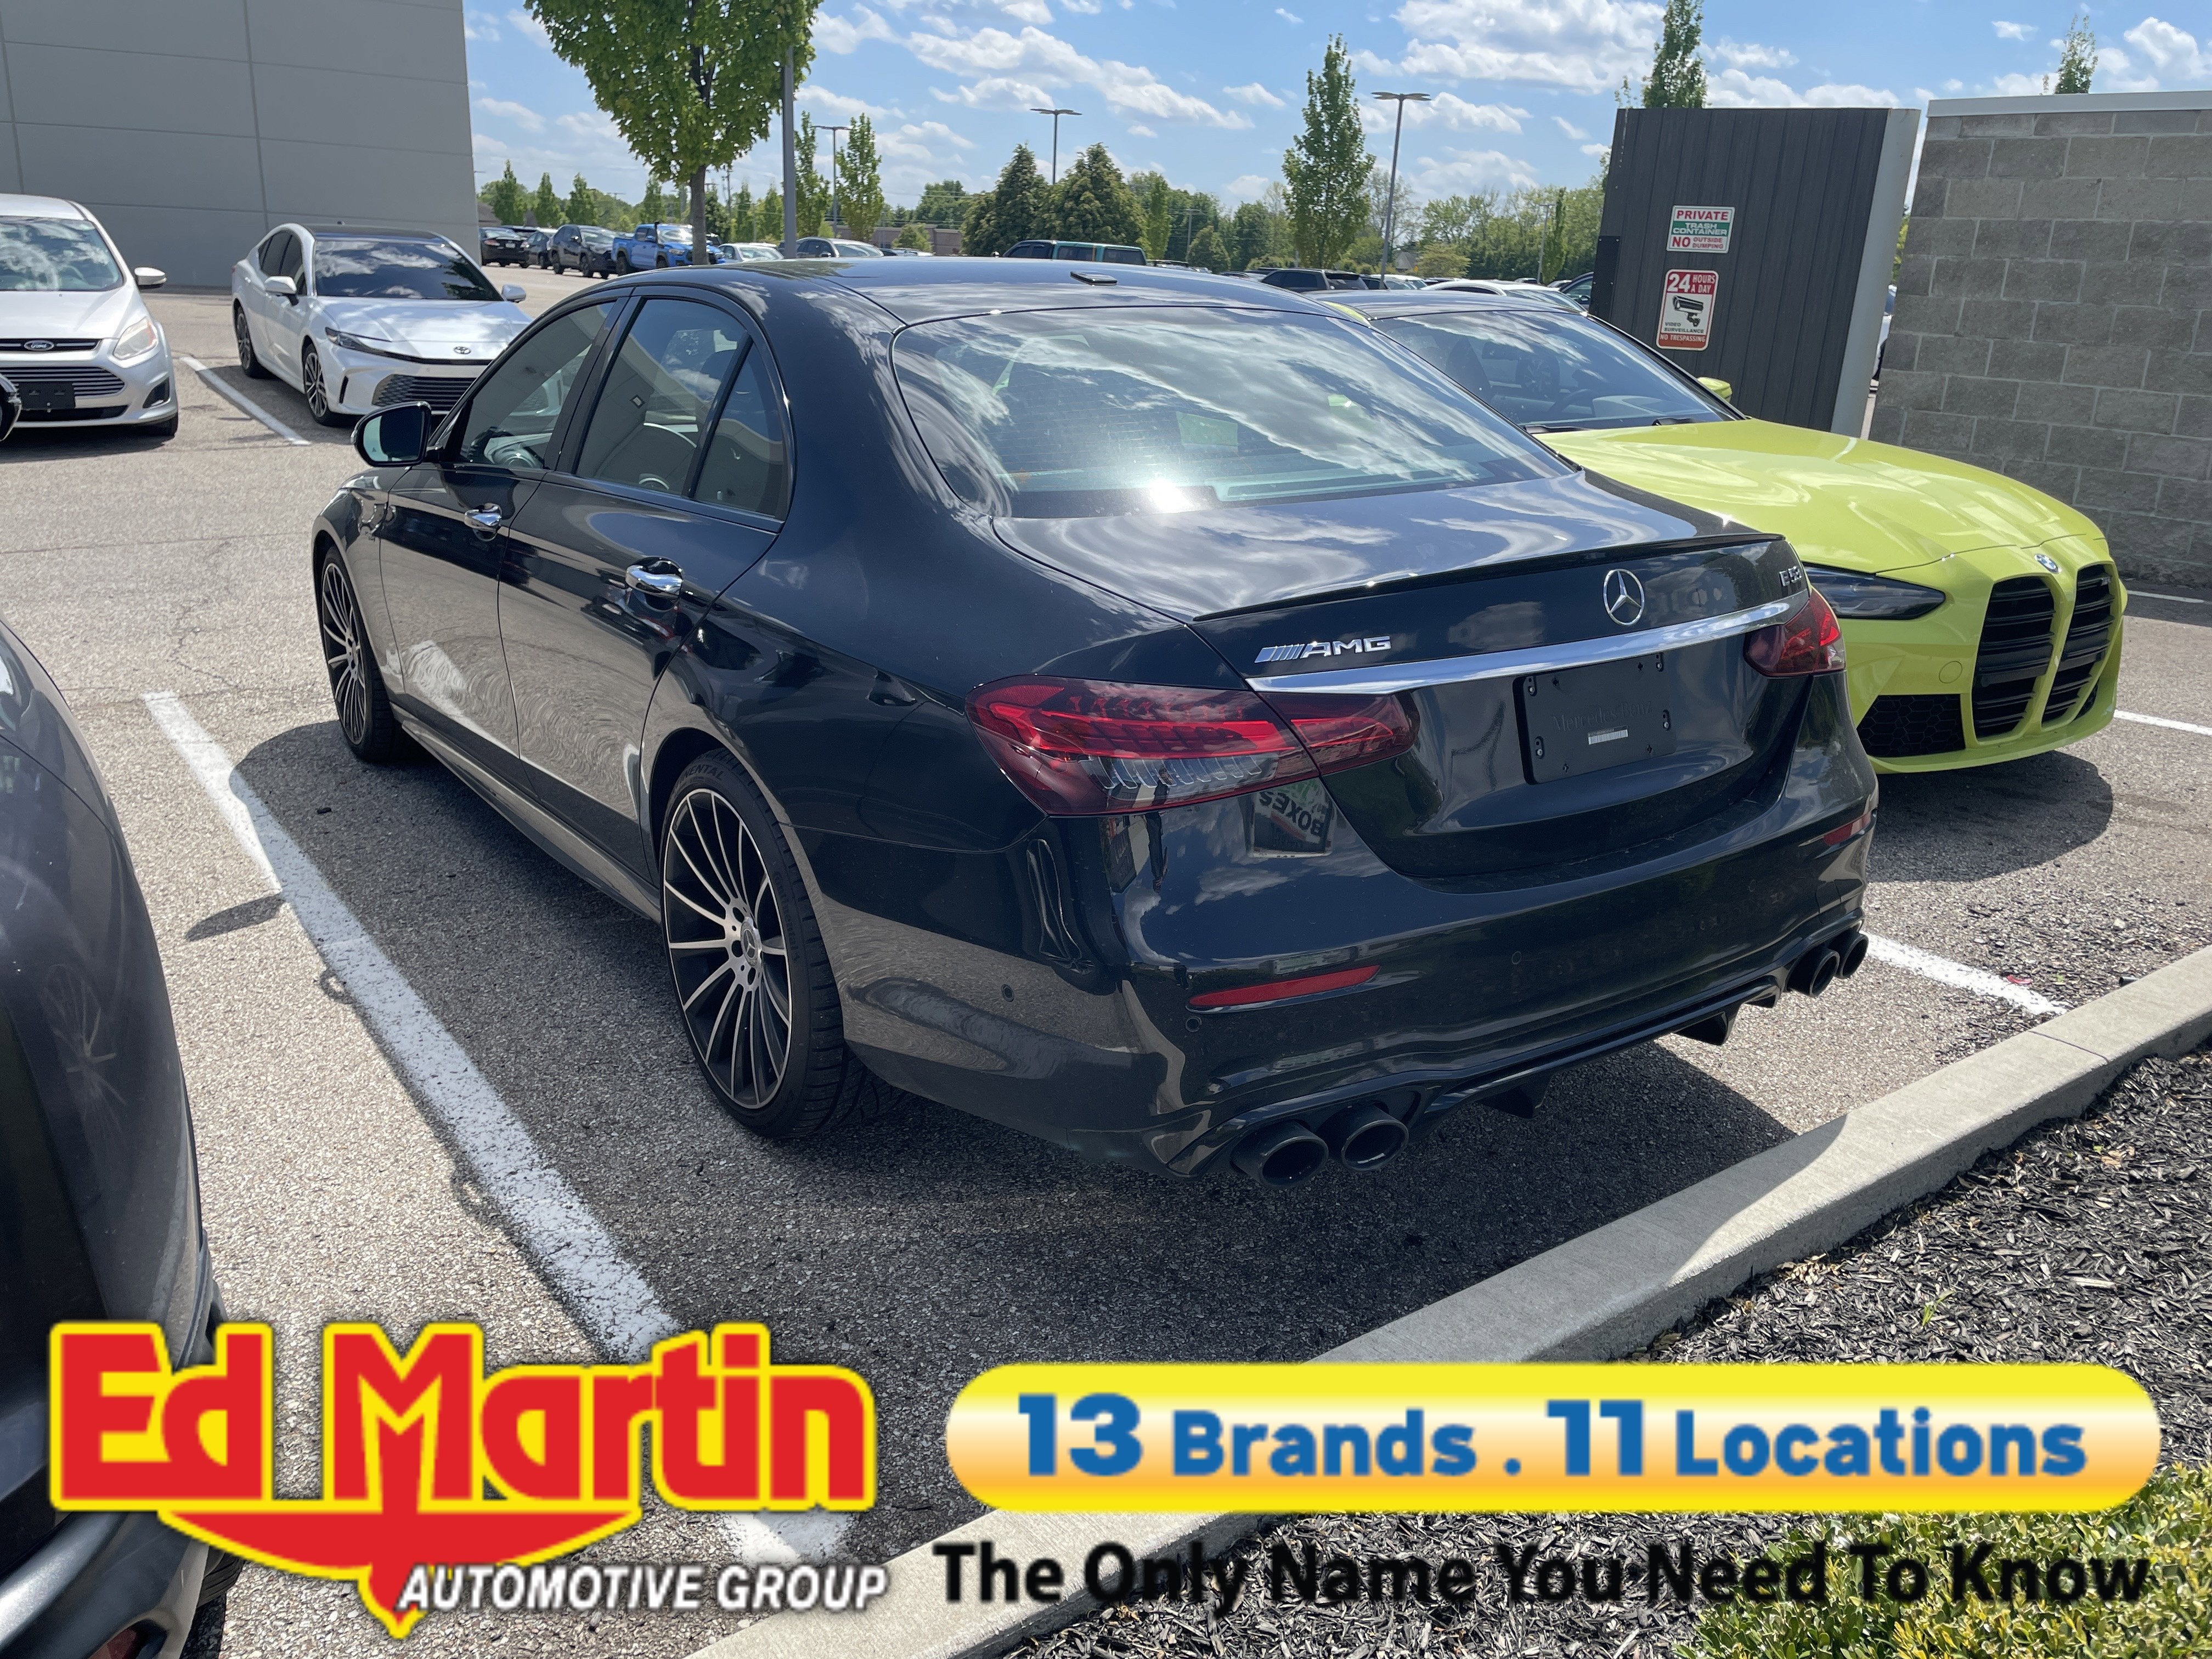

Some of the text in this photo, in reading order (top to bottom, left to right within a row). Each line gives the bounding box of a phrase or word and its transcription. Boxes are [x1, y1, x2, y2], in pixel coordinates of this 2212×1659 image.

[1677, 210, 1729, 221] PRIVATE
[1672, 227, 1728, 236] CONTAINER
[1672, 236, 1691, 248] NO
[1667, 273, 1716, 292] 24 HOURS
[1690, 284, 1712, 294] A DAY
[1670, 334, 1706, 343] TRESPASSING
[1300, 635, 1391, 659] AMG
